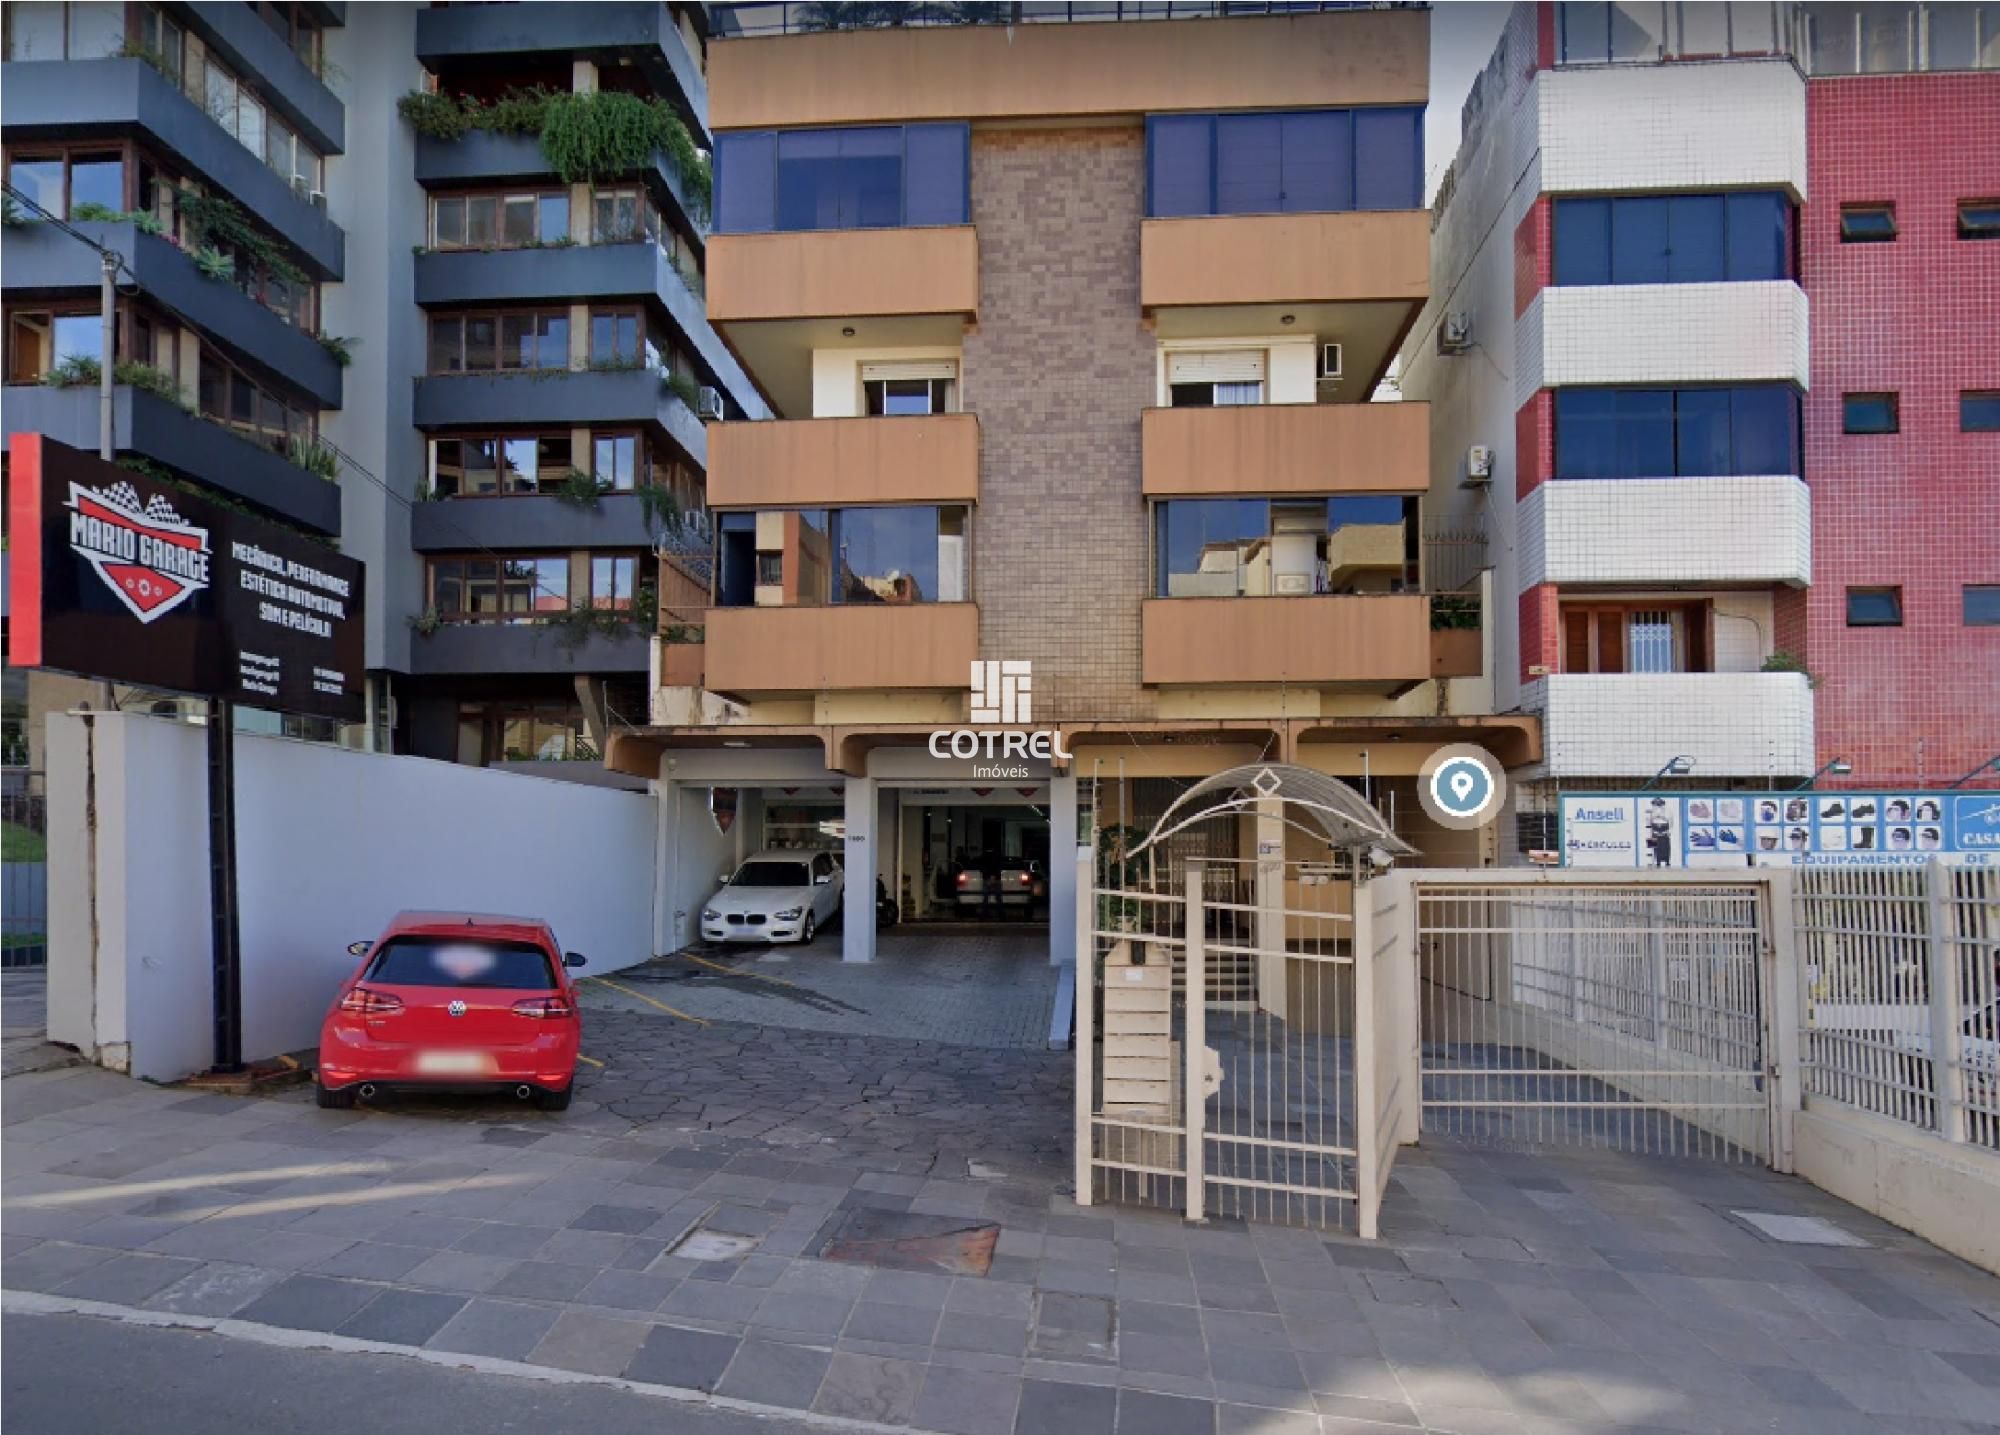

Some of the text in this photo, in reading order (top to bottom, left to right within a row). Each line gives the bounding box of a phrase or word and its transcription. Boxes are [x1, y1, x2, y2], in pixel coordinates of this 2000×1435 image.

[70, 511, 209, 582] MARIO GARAGE
[1575, 807, 1624, 821] Ansell
[1964, 853, 1991, 865] DE
